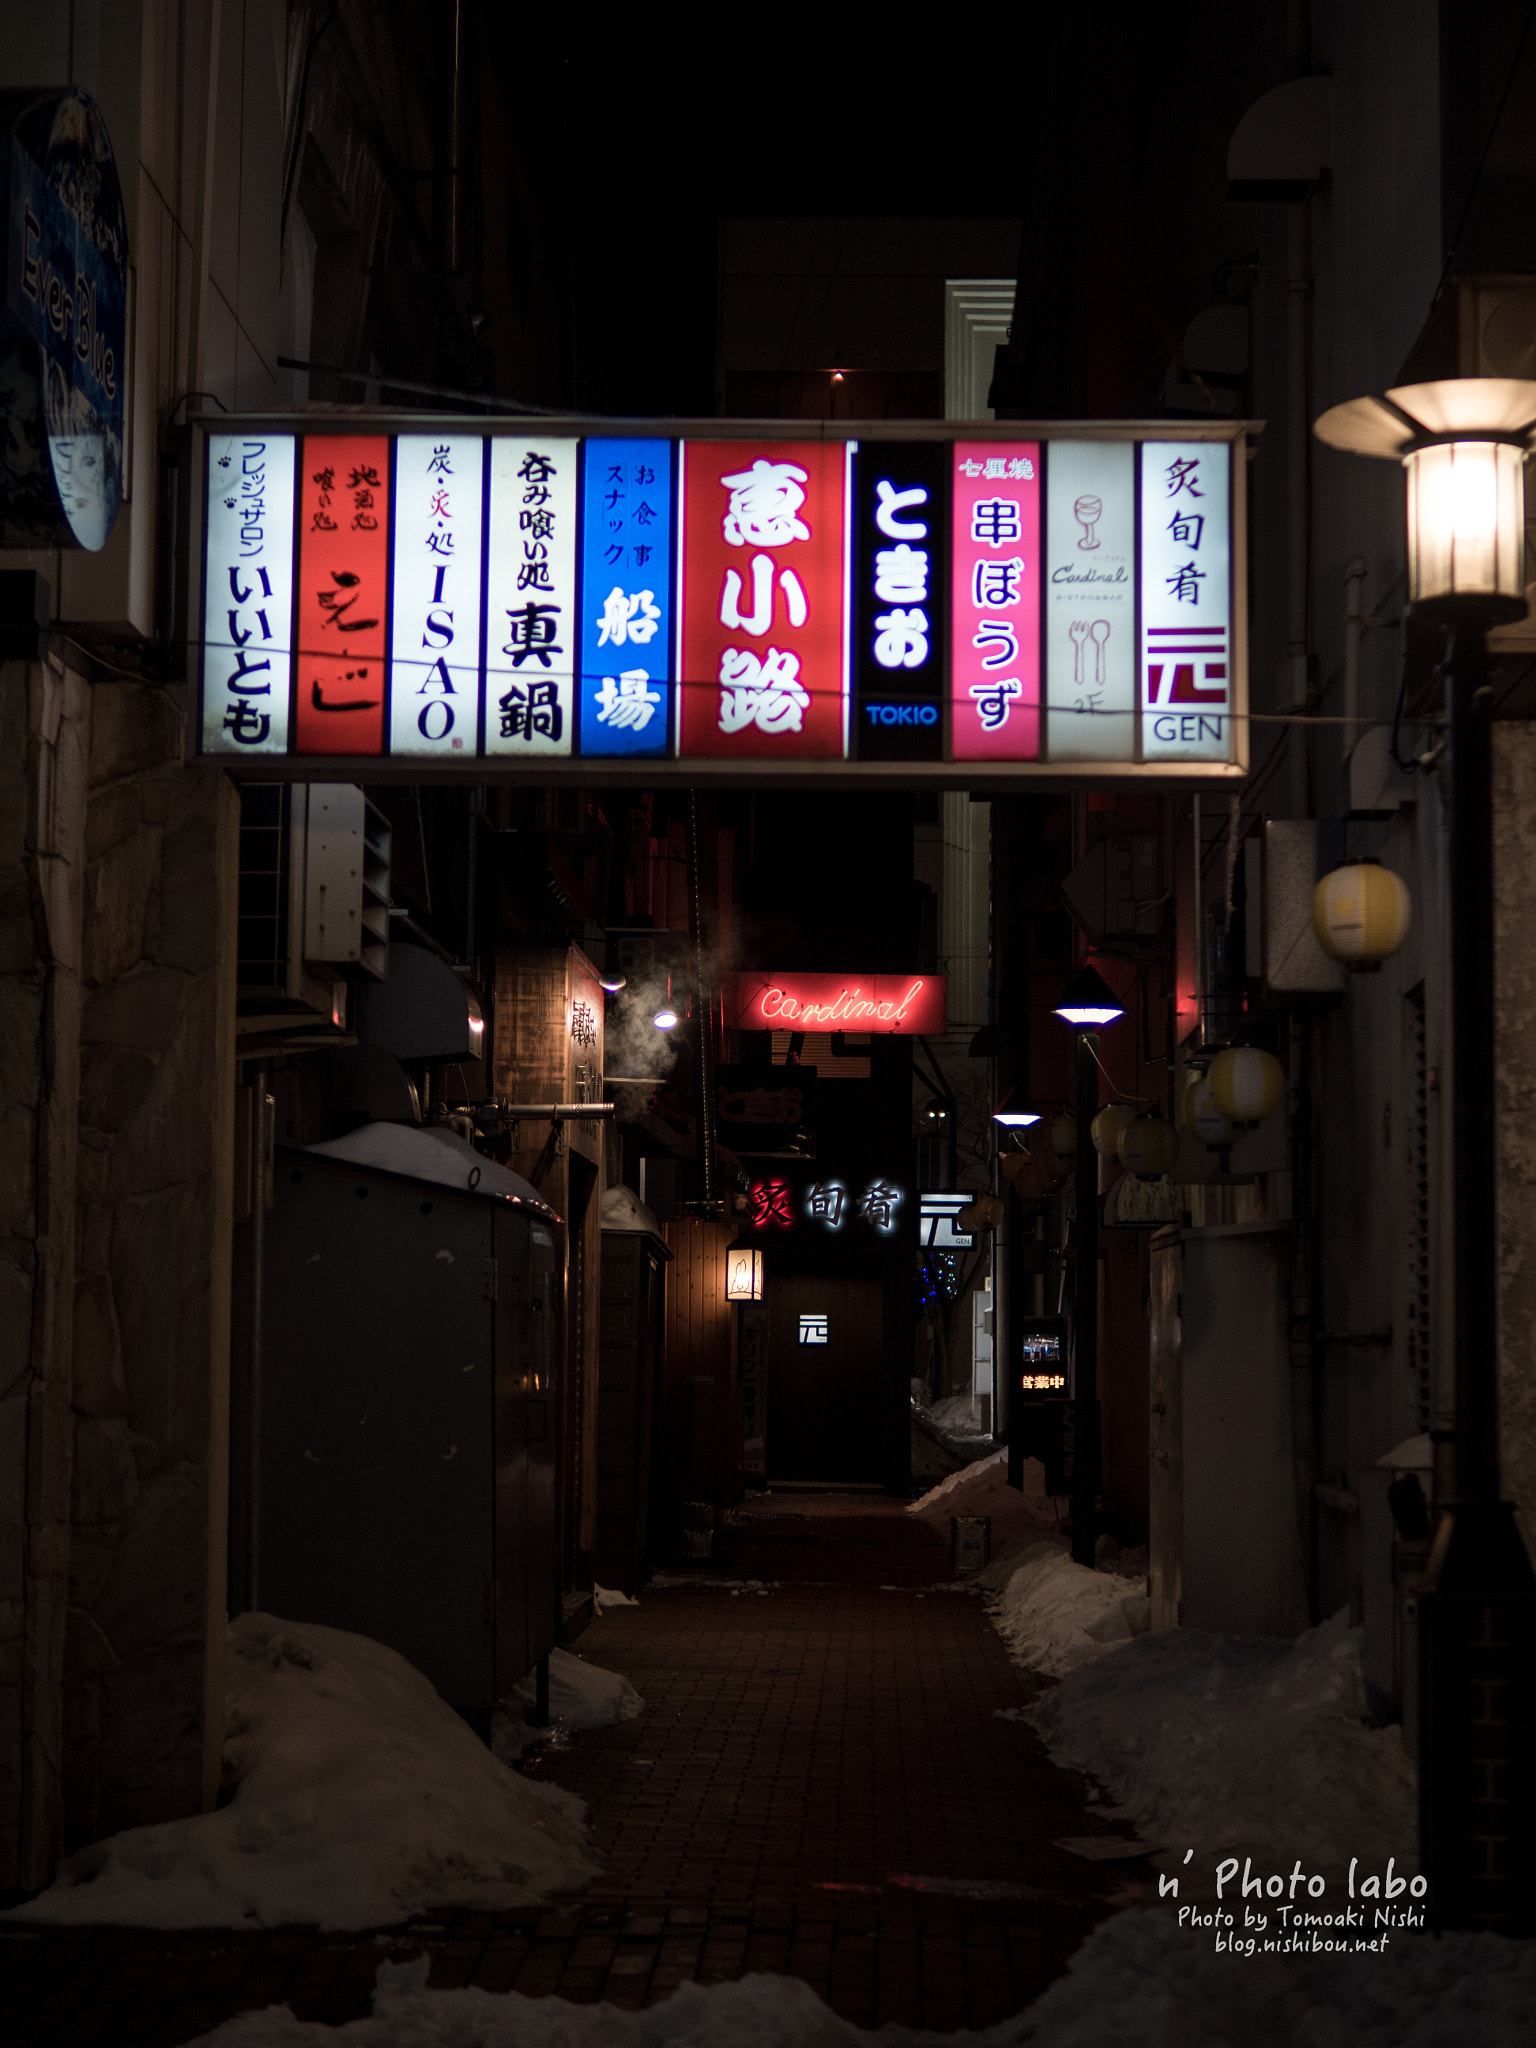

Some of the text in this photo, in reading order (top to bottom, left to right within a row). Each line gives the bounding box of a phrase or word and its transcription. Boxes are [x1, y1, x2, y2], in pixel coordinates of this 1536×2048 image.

[21, 197, 116, 400] Ever Blue
[239, 442, 267, 557] フレッシュサロン
[604, 464, 626, 566] スナック
[632, 464, 658, 567] お食事
[959, 457, 1035, 481] 七厘焼
[874, 479, 929, 668] ときお
[1052, 562, 1129, 584] Cardinal
[1165, 456, 1206, 606] 炙旬肴
[223, 566, 273, 745] いいとも
[415, 565, 459, 740] ISAO
[594, 587, 661, 732] 船場
[969, 497, 1025, 731] 串ぼうず
[866, 706, 938, 725] TOKIO
[1075, 690, 1105, 716] 2F
[1153, 715, 1223, 742] GEN
[761, 981, 924, 1023] Cardinal
[752, 1181, 899, 1229] 炙旬肴
